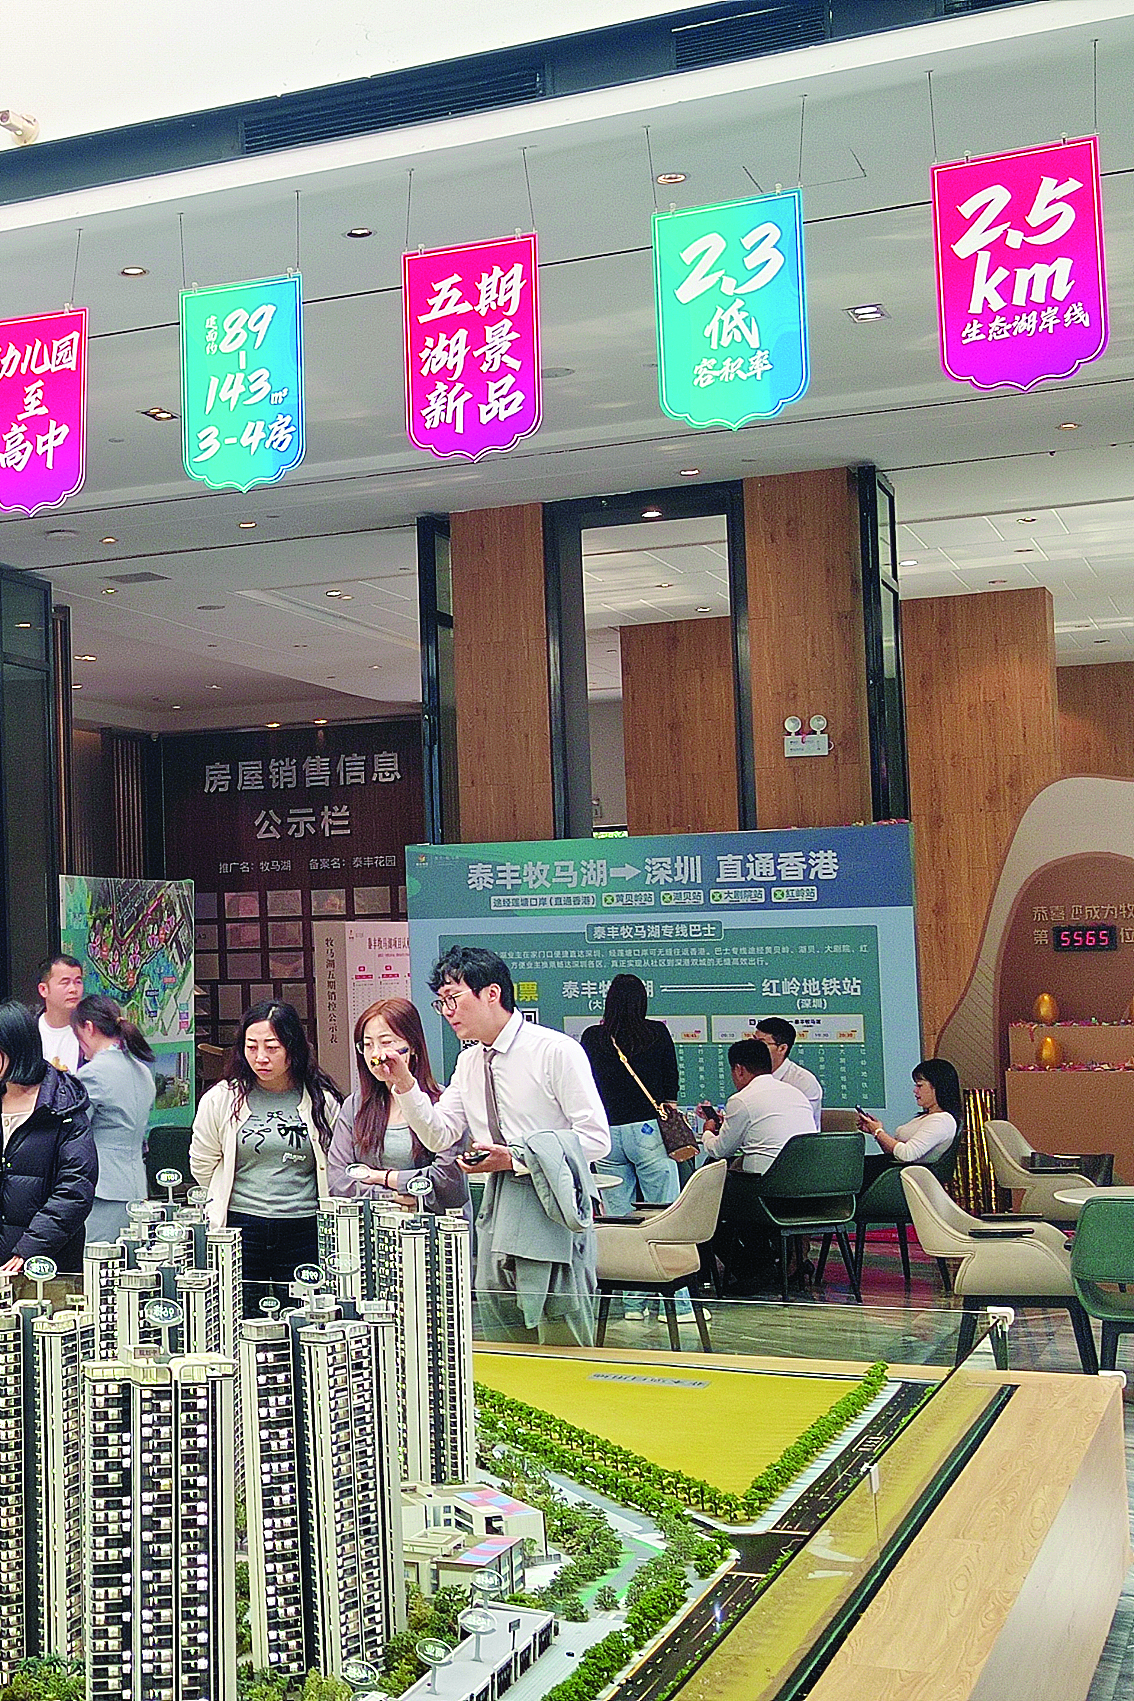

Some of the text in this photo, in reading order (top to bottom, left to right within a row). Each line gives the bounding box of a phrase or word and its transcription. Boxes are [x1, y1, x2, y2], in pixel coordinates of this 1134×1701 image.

[951, 176, 1084, 260] 2.5
[674, 221, 785, 304] 2.3
[967, 251, 1075, 314] km
[417, 263, 526, 324] 五期
[219, 303, 277, 354] 89
[704, 298, 760, 351] 低
[962, 302, 1090, 346] 生态湖岸线
[419, 320, 523, 381] 湖景
[693, 349, 774, 388] 容积率
[16, 380, 50, 420] 至
[420, 373, 525, 434] 新品
[192, 413, 297, 463] 3-4房
[203, 751, 402, 793] 房屋销售信息
[254, 805, 351, 840] 公示栏
[467, 850, 839, 891] 泰丰牧马湖 深圳 直通香港
[593, 924, 716, 939] 泰丰牧马湖专线巴士
[1033, 929, 1049, 944] 第
[1060, 930, 1109, 946] 5565
[324, 937, 339, 1044] 牧马湖五期销控公示表
[761, 977, 862, 997] 红岭地铁站
